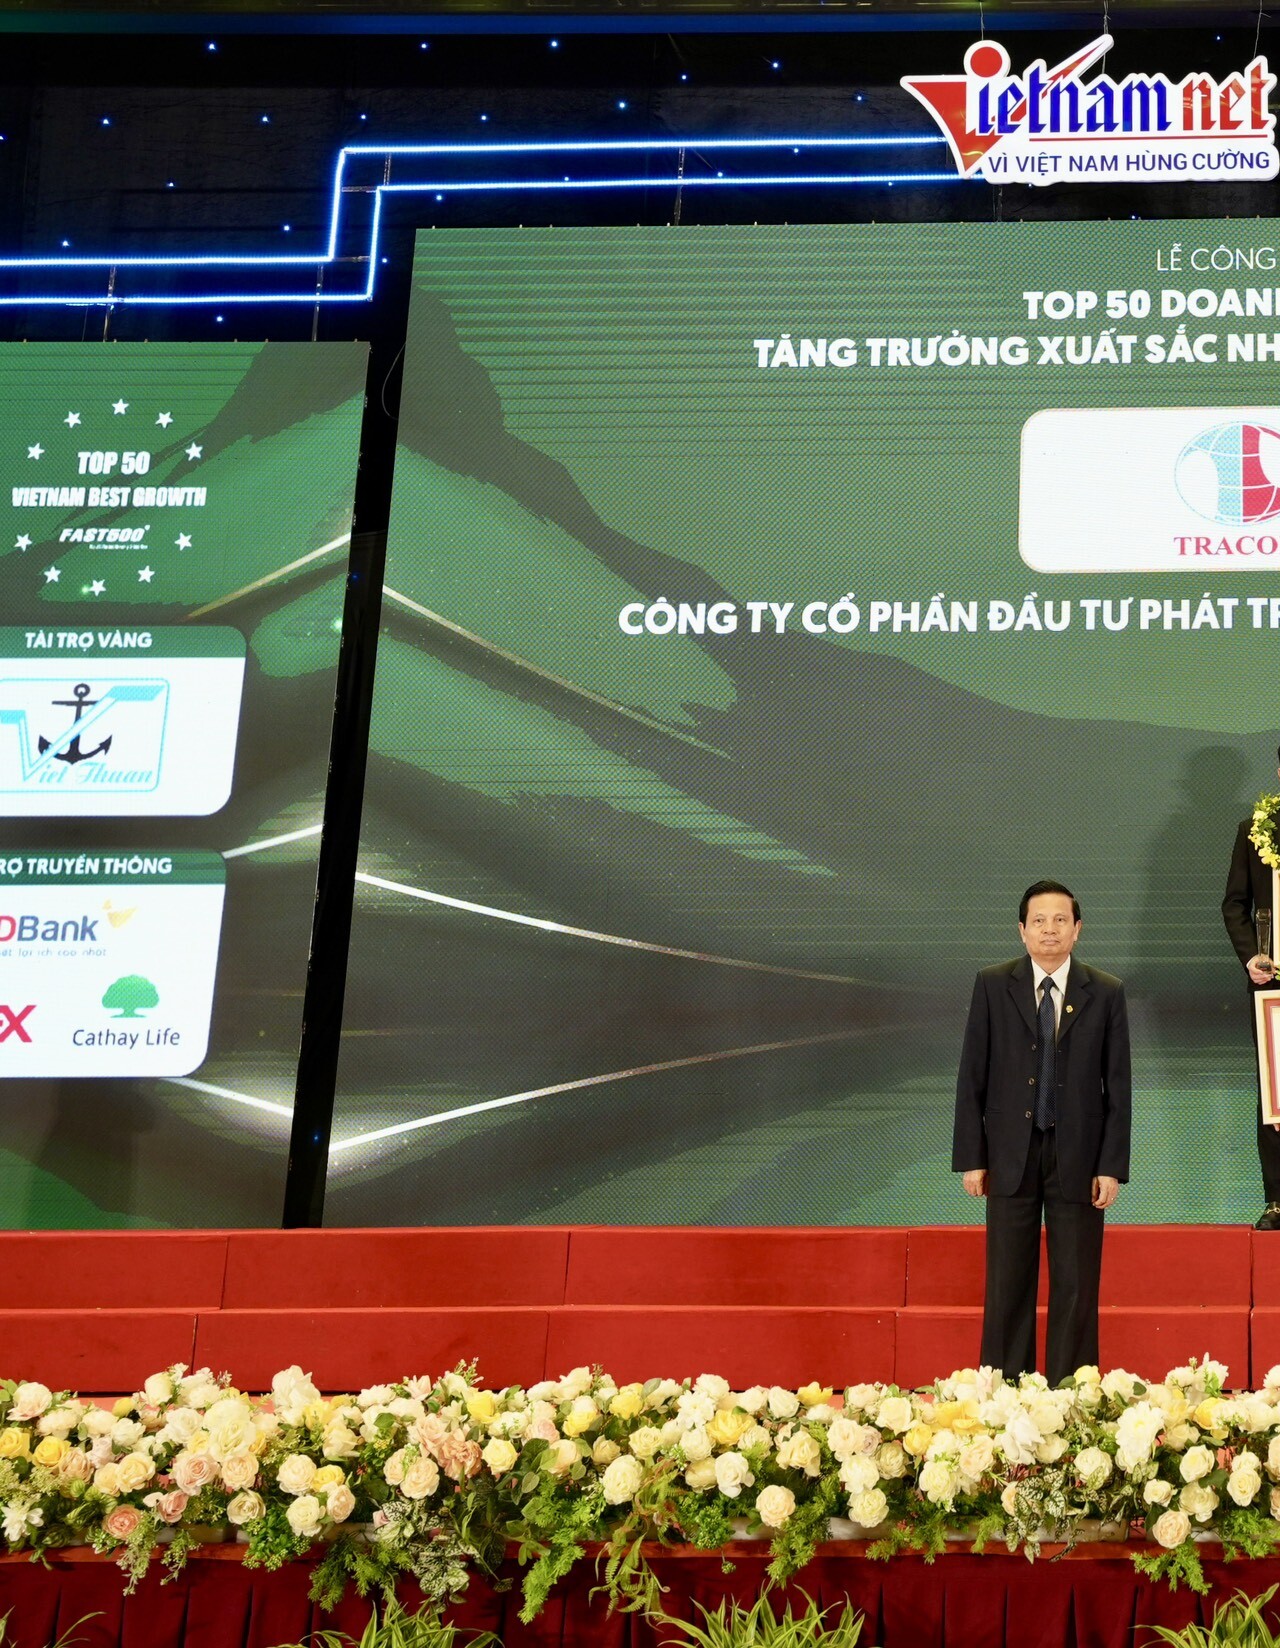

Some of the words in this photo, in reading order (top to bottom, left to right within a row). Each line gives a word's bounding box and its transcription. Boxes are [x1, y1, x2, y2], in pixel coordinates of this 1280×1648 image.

[988, 151, 1008, 173] VÌ
[1016, 151, 1062, 176] VIỆT
[1069, 154, 1119, 172] NAM
[1126, 149, 1188, 172] HÙNG
[1192, 148, 1270, 171] CƯỜNG
[1157, 243, 1183, 272] LỄ
[1190, 244, 1277, 271] CÔNG
[1022, 290, 1098, 320] TOP
[1106, 289, 1151, 319] 50
[753, 334, 858, 368] TĂNG
[866, 329, 1030, 366] TRƯỞNG
[1036, 328, 1137, 365] XUẤT
[1144, 324, 1218, 364] SẮC
[77, 451, 118, 475] TOP
[121, 451, 150, 475] 50
[12, 487, 86, 507] VIETNAM
[88, 487, 131, 507] BEST
[132, 487, 207, 507] GROWTH
[59, 527, 146, 543] FAST500
[618, 597, 739, 635] CÔNG
[746, 602, 795, 634] TY
[801, 592, 860, 634] CỔ
[869, 592, 978, 632] PHẦN
[987, 592, 1071, 631] ĐẦU
[1080, 596, 1135, 632] TƯ
[1140, 592, 1239, 630] PHÁT
[25, 630, 53, 648] TÀI
[57, 631, 95, 652] TRỢ
[98, 630, 153, 648] VÀNG
[27, 854, 100, 875] TRUYỀN
[103, 856, 173, 874] THÔNG
[72, 1028, 139, 1049] Cathay
[146, 1028, 180, 1046] Life
